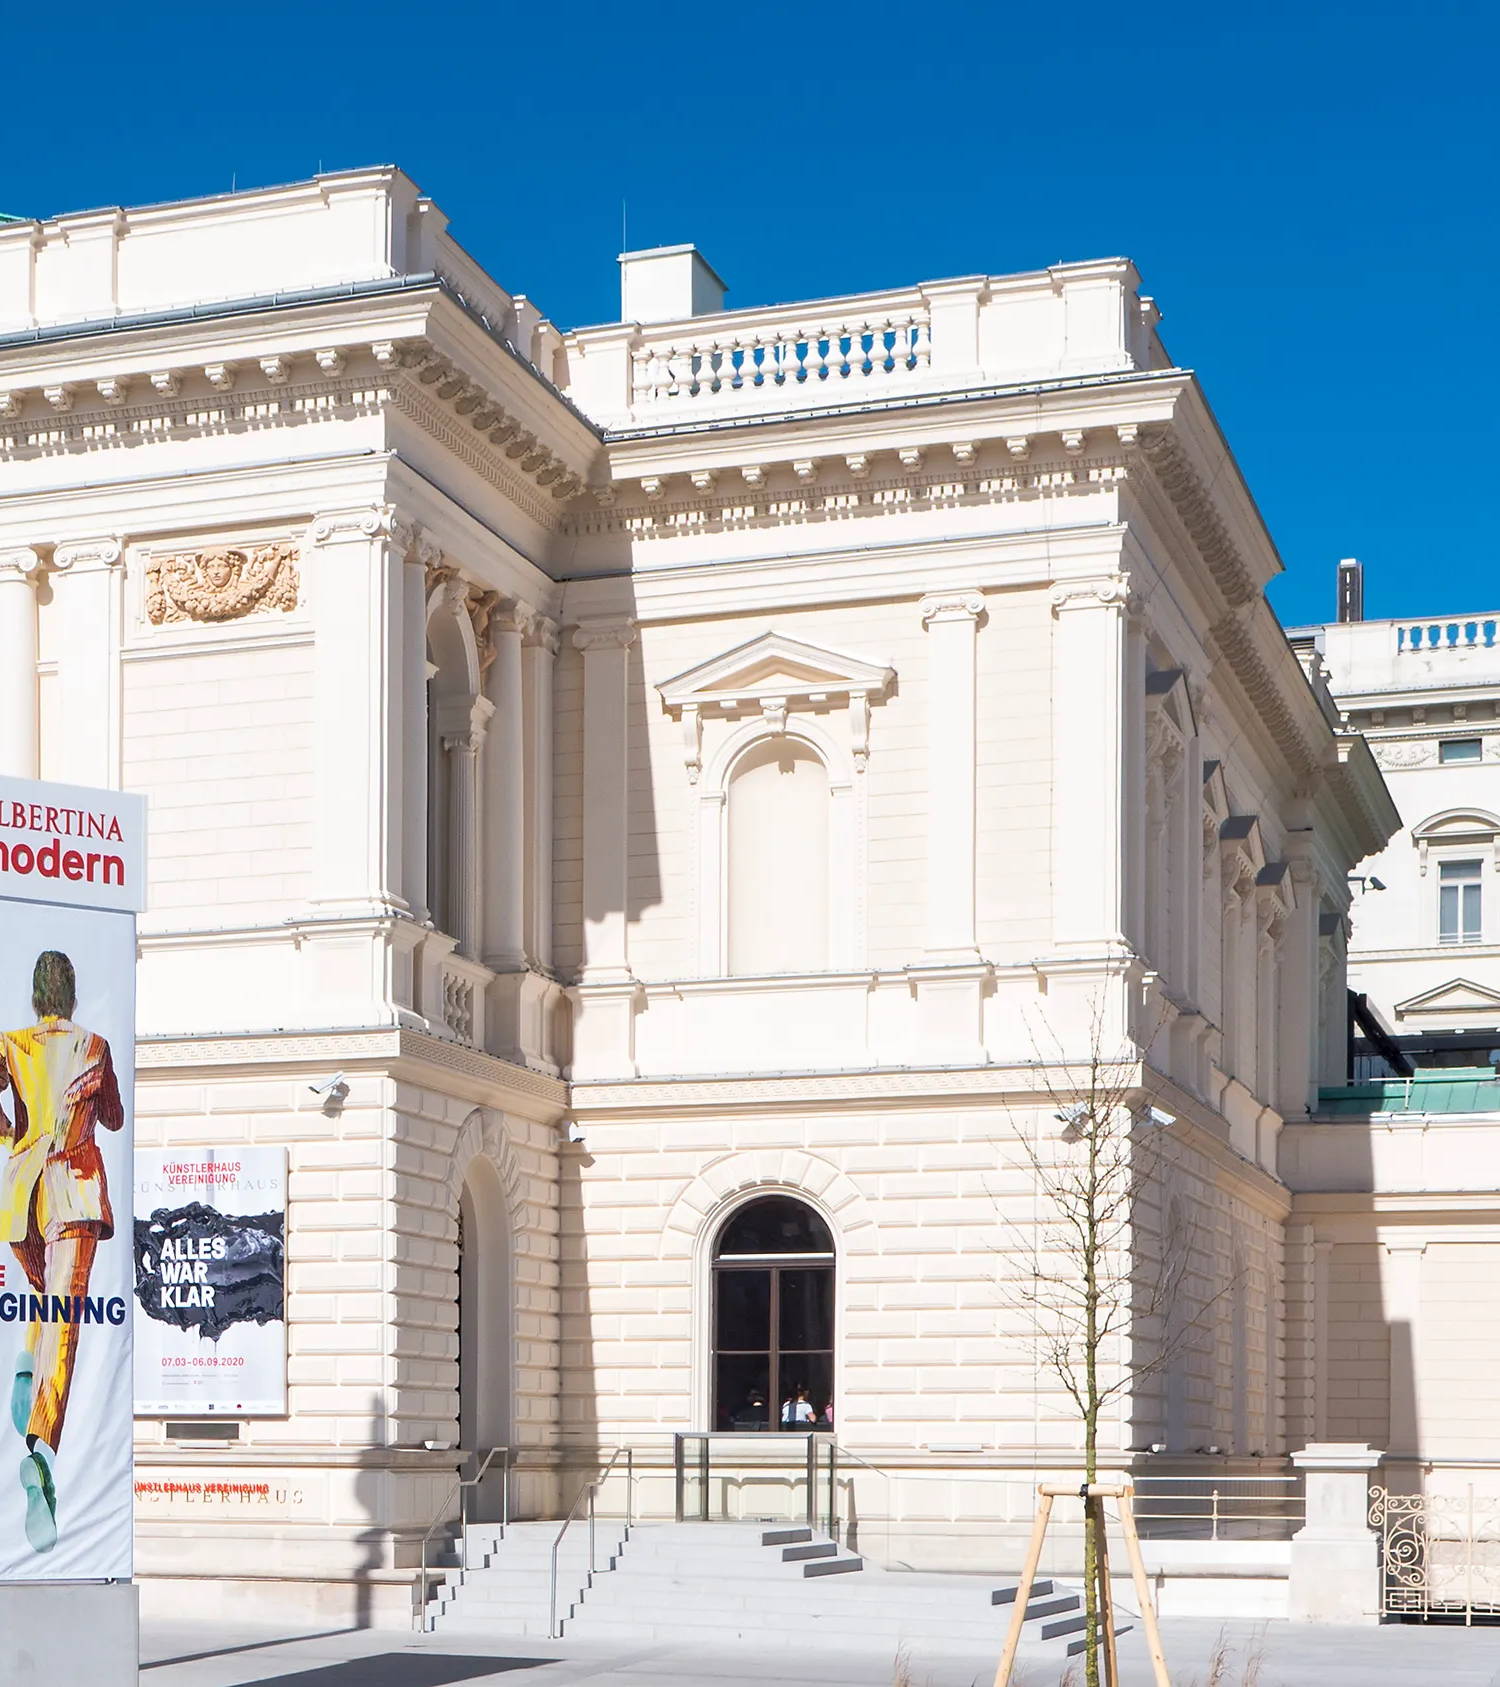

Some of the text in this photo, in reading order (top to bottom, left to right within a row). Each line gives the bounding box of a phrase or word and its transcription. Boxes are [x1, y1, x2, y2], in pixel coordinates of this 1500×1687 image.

[162, 1161, 241, 1174] KÜNSTLERHAUS
[134, 1179, 278, 1194] ÜNSTLERHAUS
[168, 1173, 236, 1185] VEREINIGUNG
[160, 1237, 226, 1260] ALLES
[160, 1261, 208, 1284] WAR
[161, 1285, 215, 1309] KLAR
[203, 1483, 269, 1495] VEREINIGUNG
